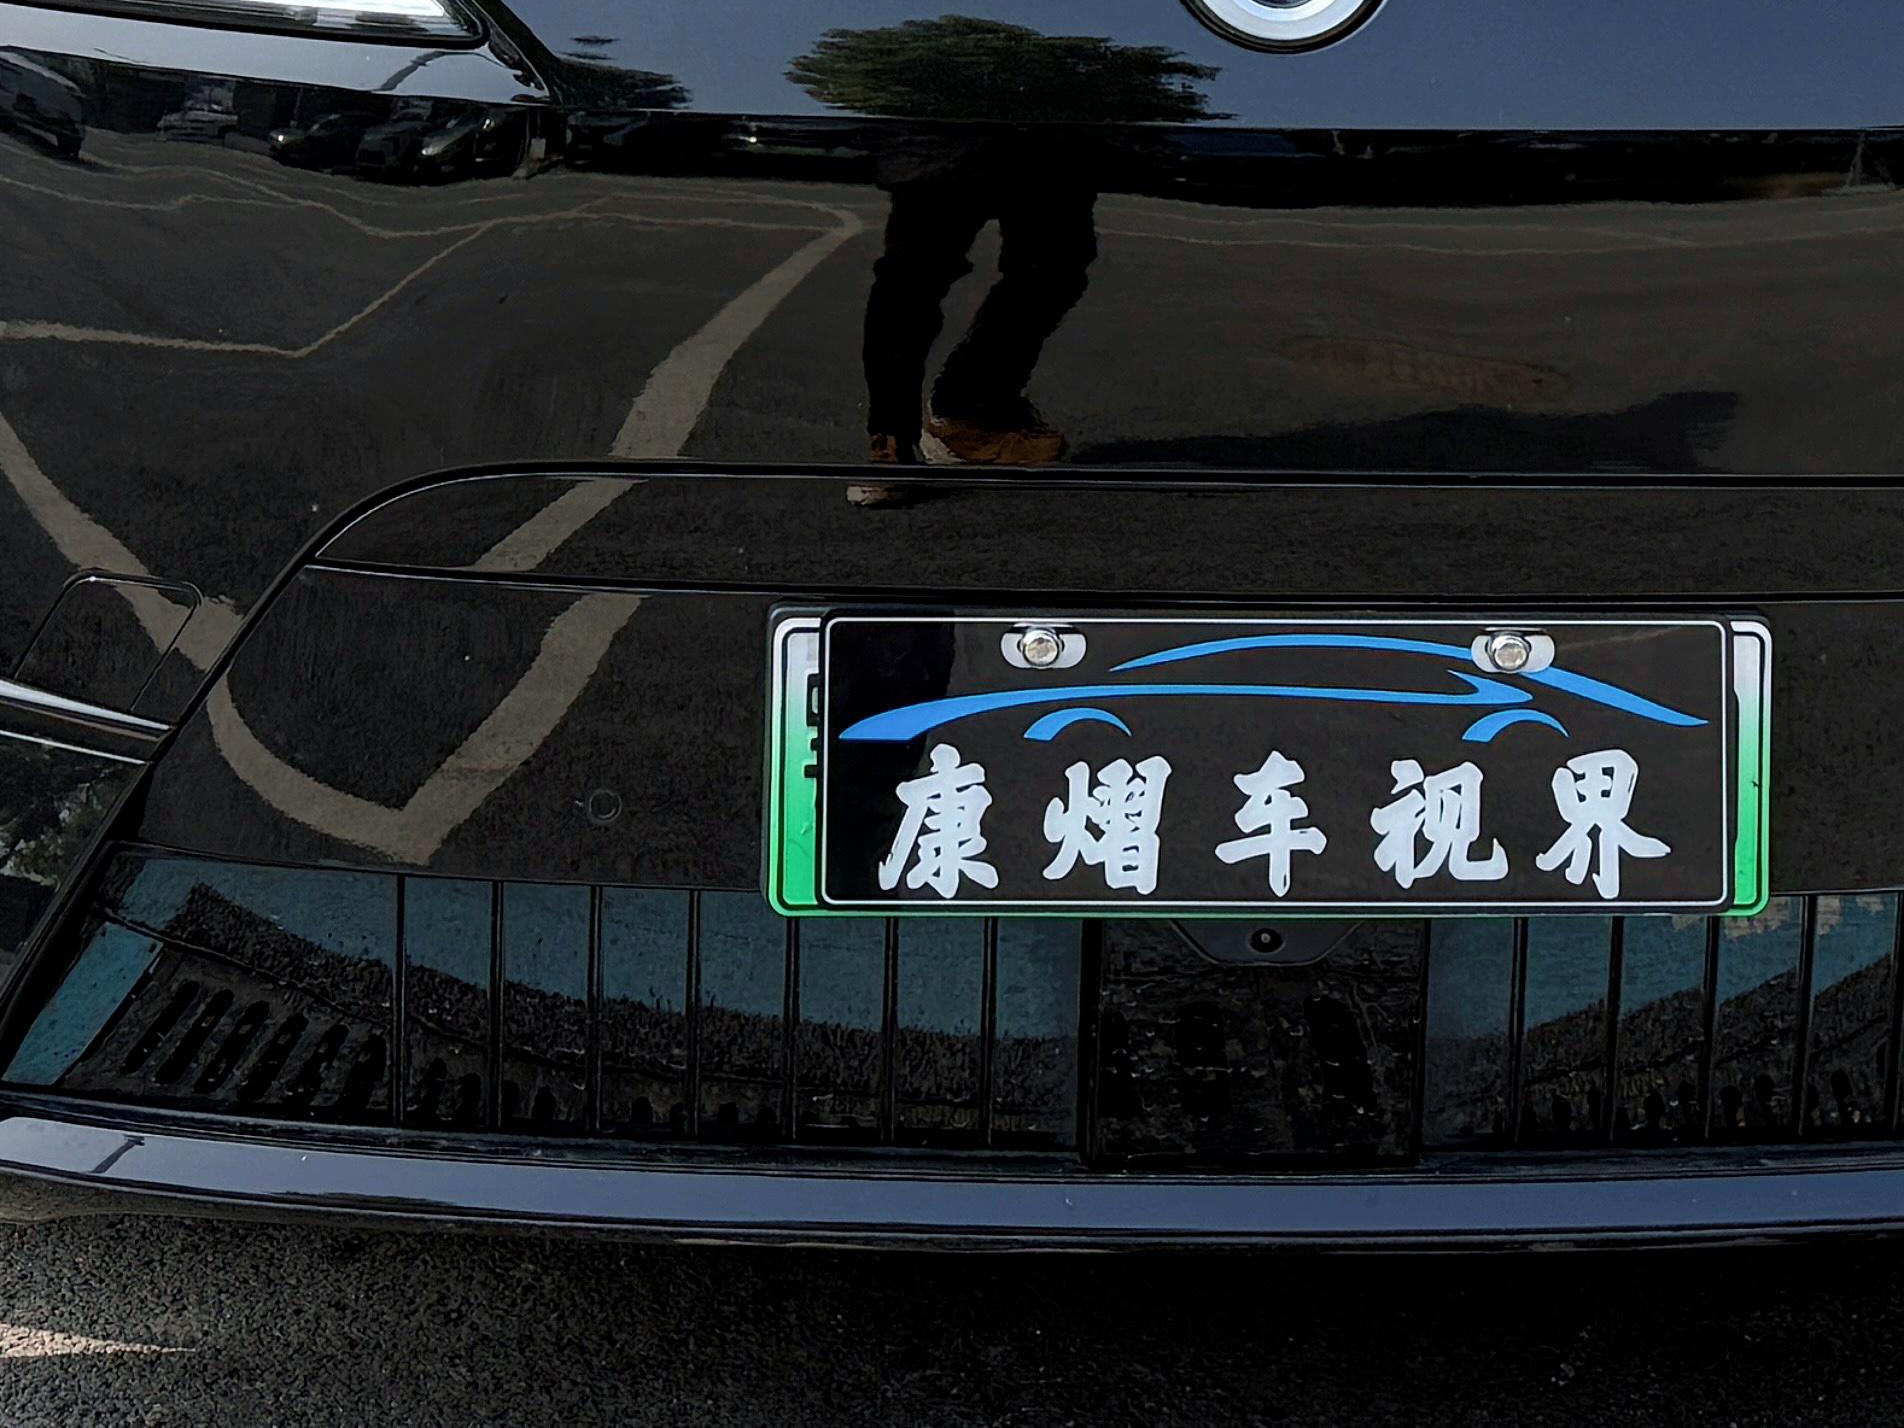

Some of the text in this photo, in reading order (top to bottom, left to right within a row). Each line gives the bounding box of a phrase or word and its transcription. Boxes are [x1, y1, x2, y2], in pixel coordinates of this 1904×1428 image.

[878, 742, 1673, 899] 康熠车视界
